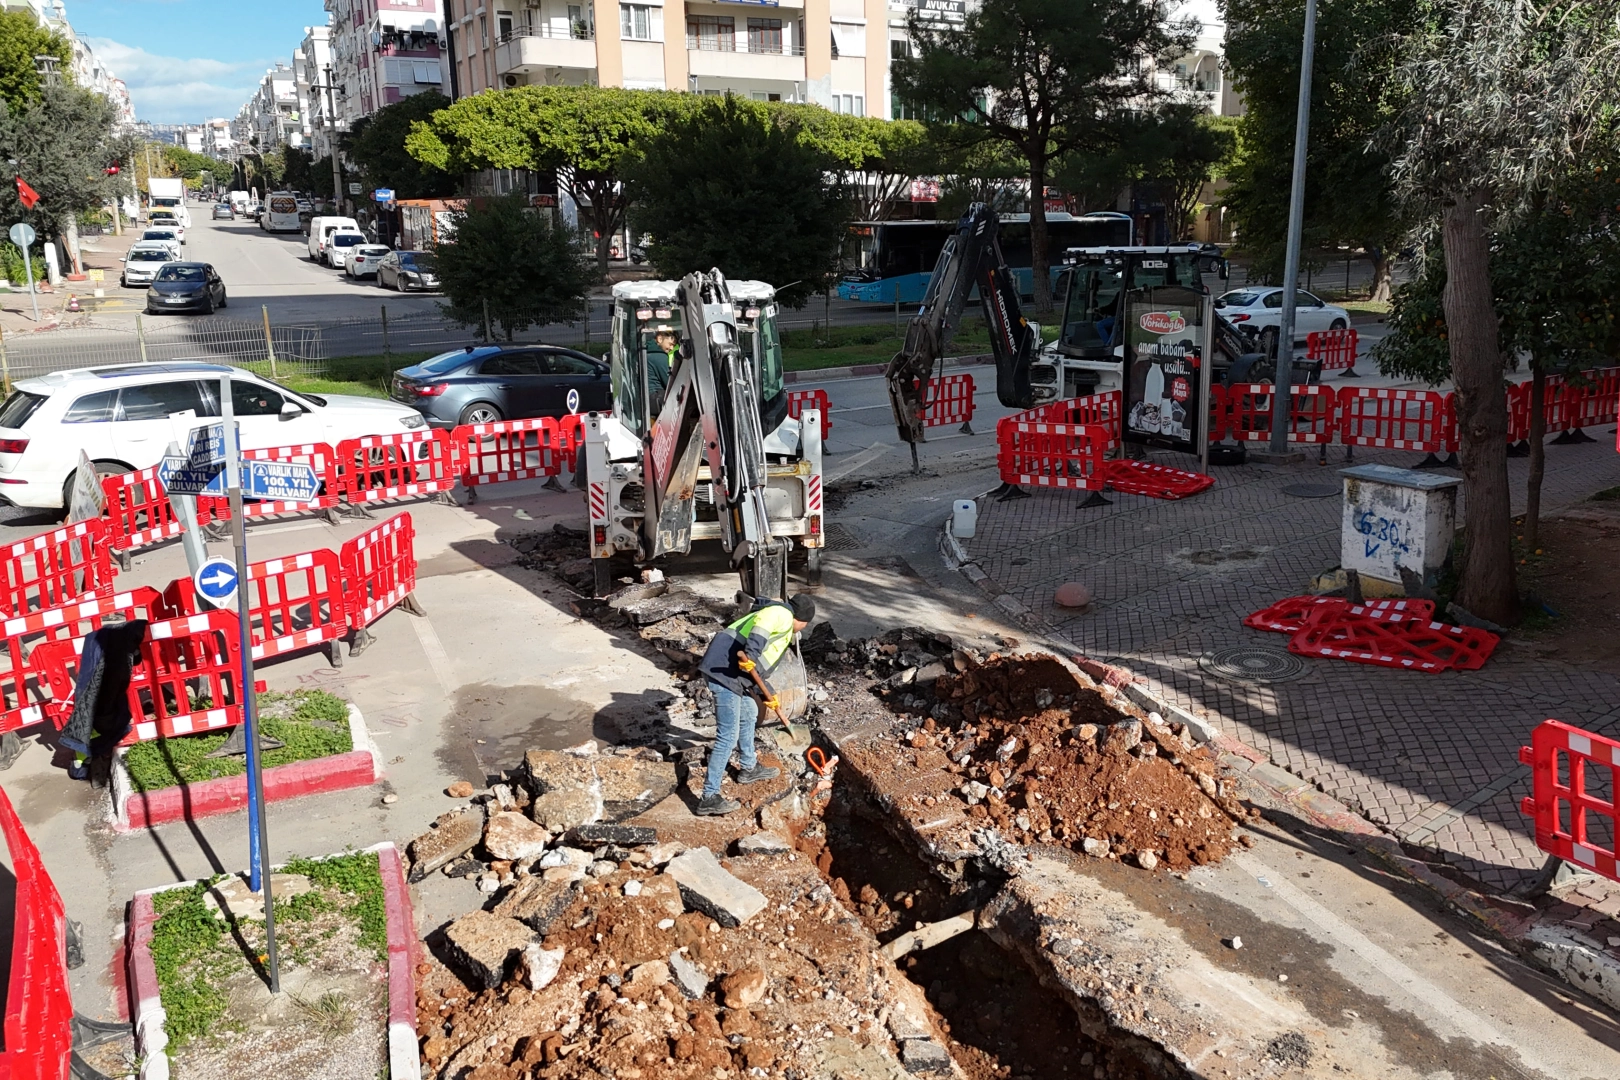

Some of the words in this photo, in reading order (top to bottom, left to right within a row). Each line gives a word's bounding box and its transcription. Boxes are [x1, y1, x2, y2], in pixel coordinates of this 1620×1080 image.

[925, 0, 959, 11] AVUKAT
[1138, 342, 1158, 355] anam
[1160, 339, 1186, 357] babam
[1174, 381, 1186, 390] Kara
[162, 470, 186, 481] 100.
[190, 472, 210, 482] YIL
[267, 465, 292, 477] VARLIK
[292, 467, 310, 478] MAH.
[168, 481, 208, 492] BULVARI
[263, 476, 289, 487] 100.
[292, 478, 313, 488] YIL
[268, 486, 310, 498] BULVARI
